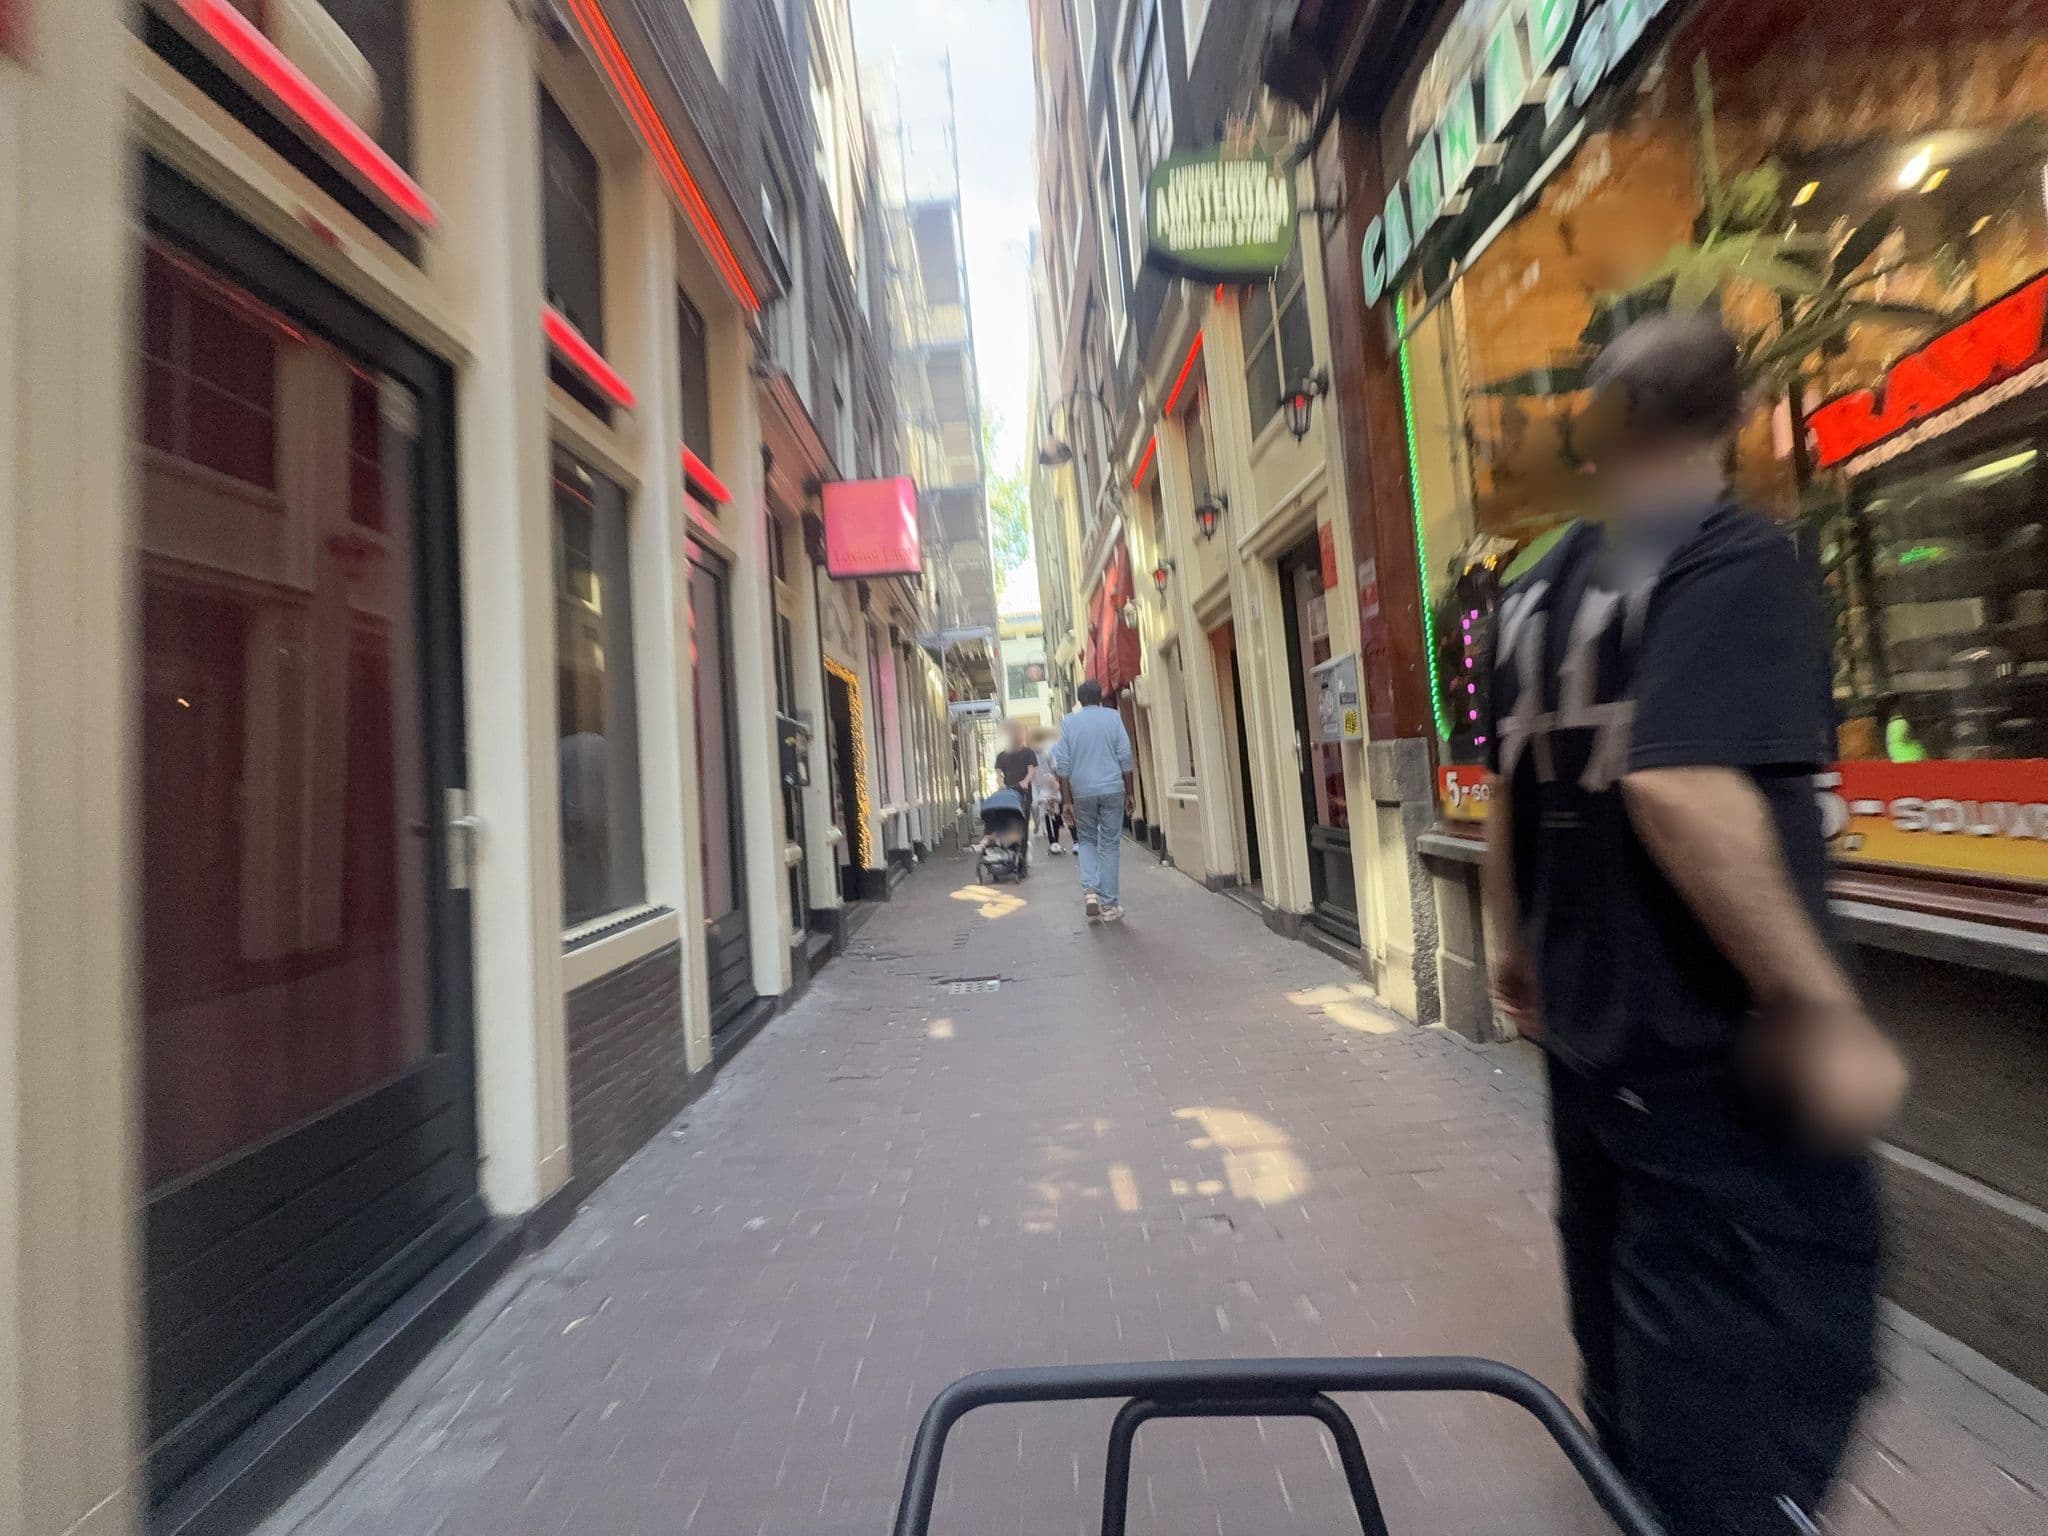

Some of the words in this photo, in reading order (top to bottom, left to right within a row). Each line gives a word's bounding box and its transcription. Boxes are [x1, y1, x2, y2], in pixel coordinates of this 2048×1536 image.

[1156, 175, 1289, 239] AMSTERDAM
[1168, 221, 1234, 250] SOUVENIR
[1236, 217, 1281, 245] STORE
